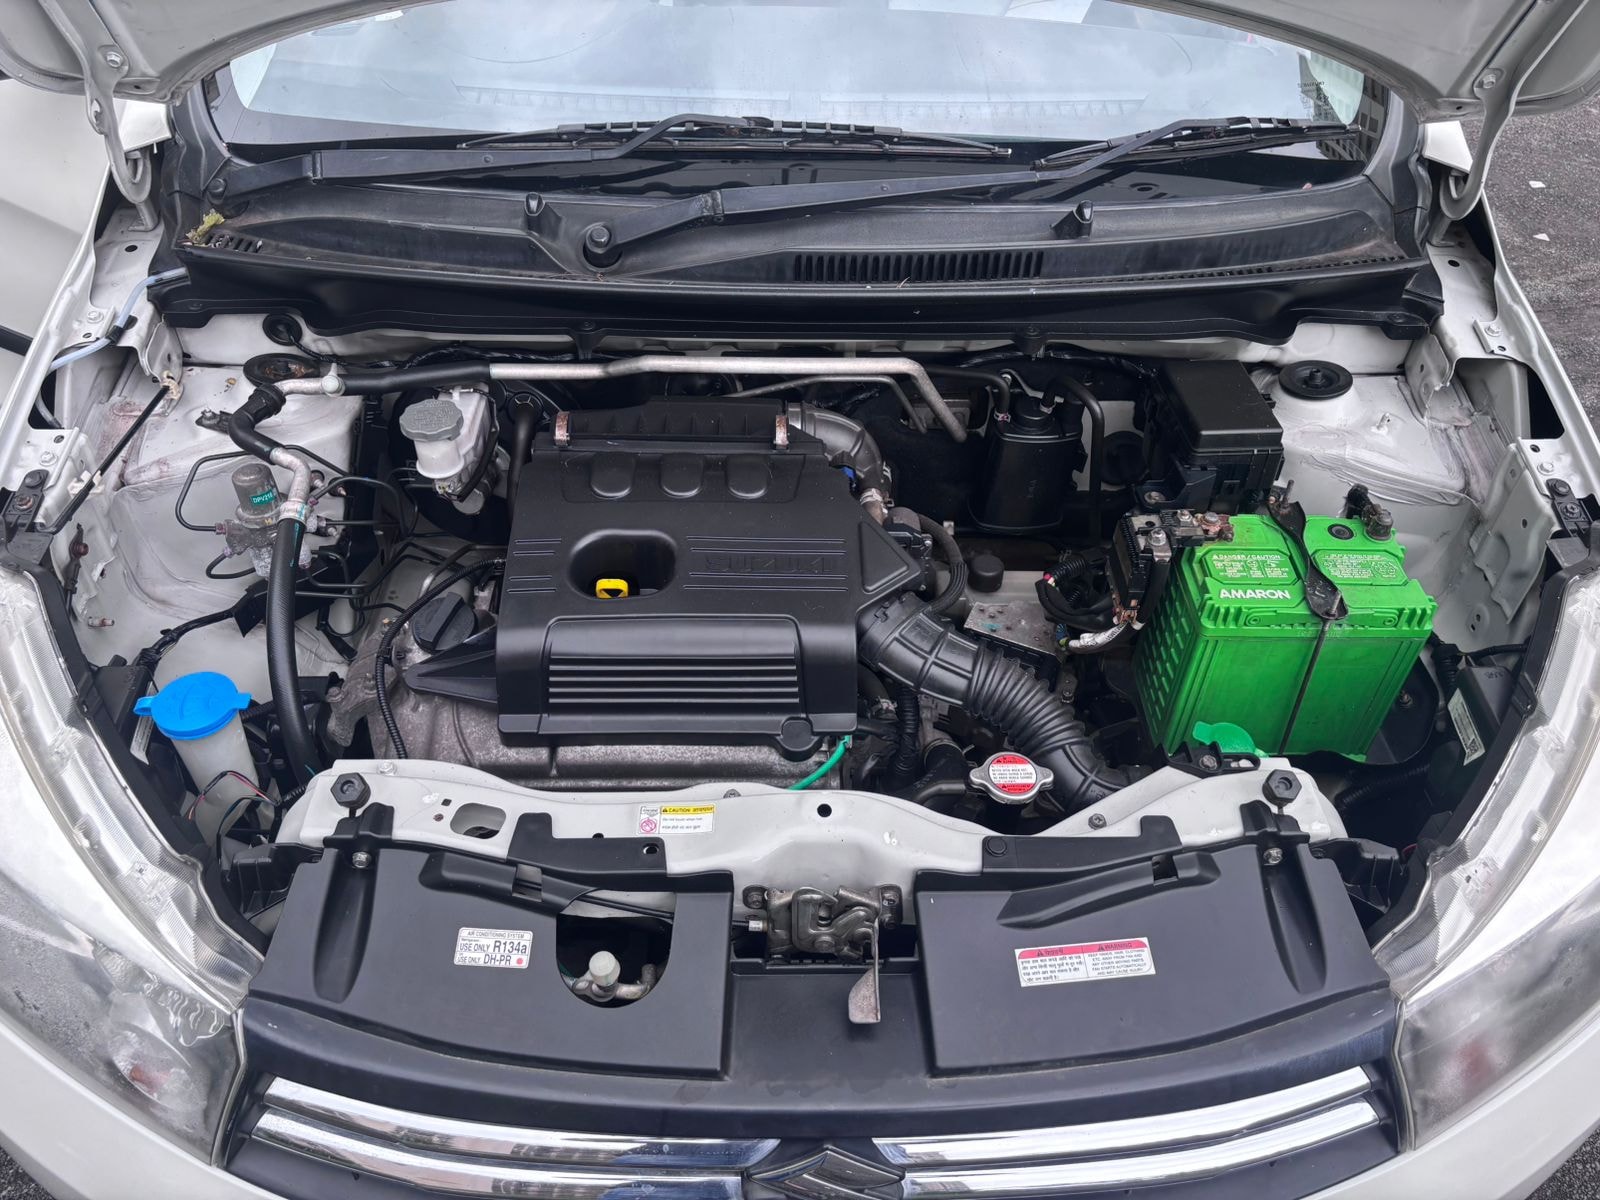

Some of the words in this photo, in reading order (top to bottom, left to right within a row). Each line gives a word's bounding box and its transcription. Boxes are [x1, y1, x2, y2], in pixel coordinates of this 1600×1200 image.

[704, 554, 834, 574] SUZUKI
[1219, 588, 1291, 599] AMARON
[475, 931, 507, 939] CONDITIONING
[459, 942, 473, 952] USE
[473, 943, 491, 952] ONLY
[492, 940, 528, 954] R134a
[1104, 942, 1133, 951] WARNING
[468, 956, 482, 964] ONLY
[483, 953, 512, 966] DH-PR
